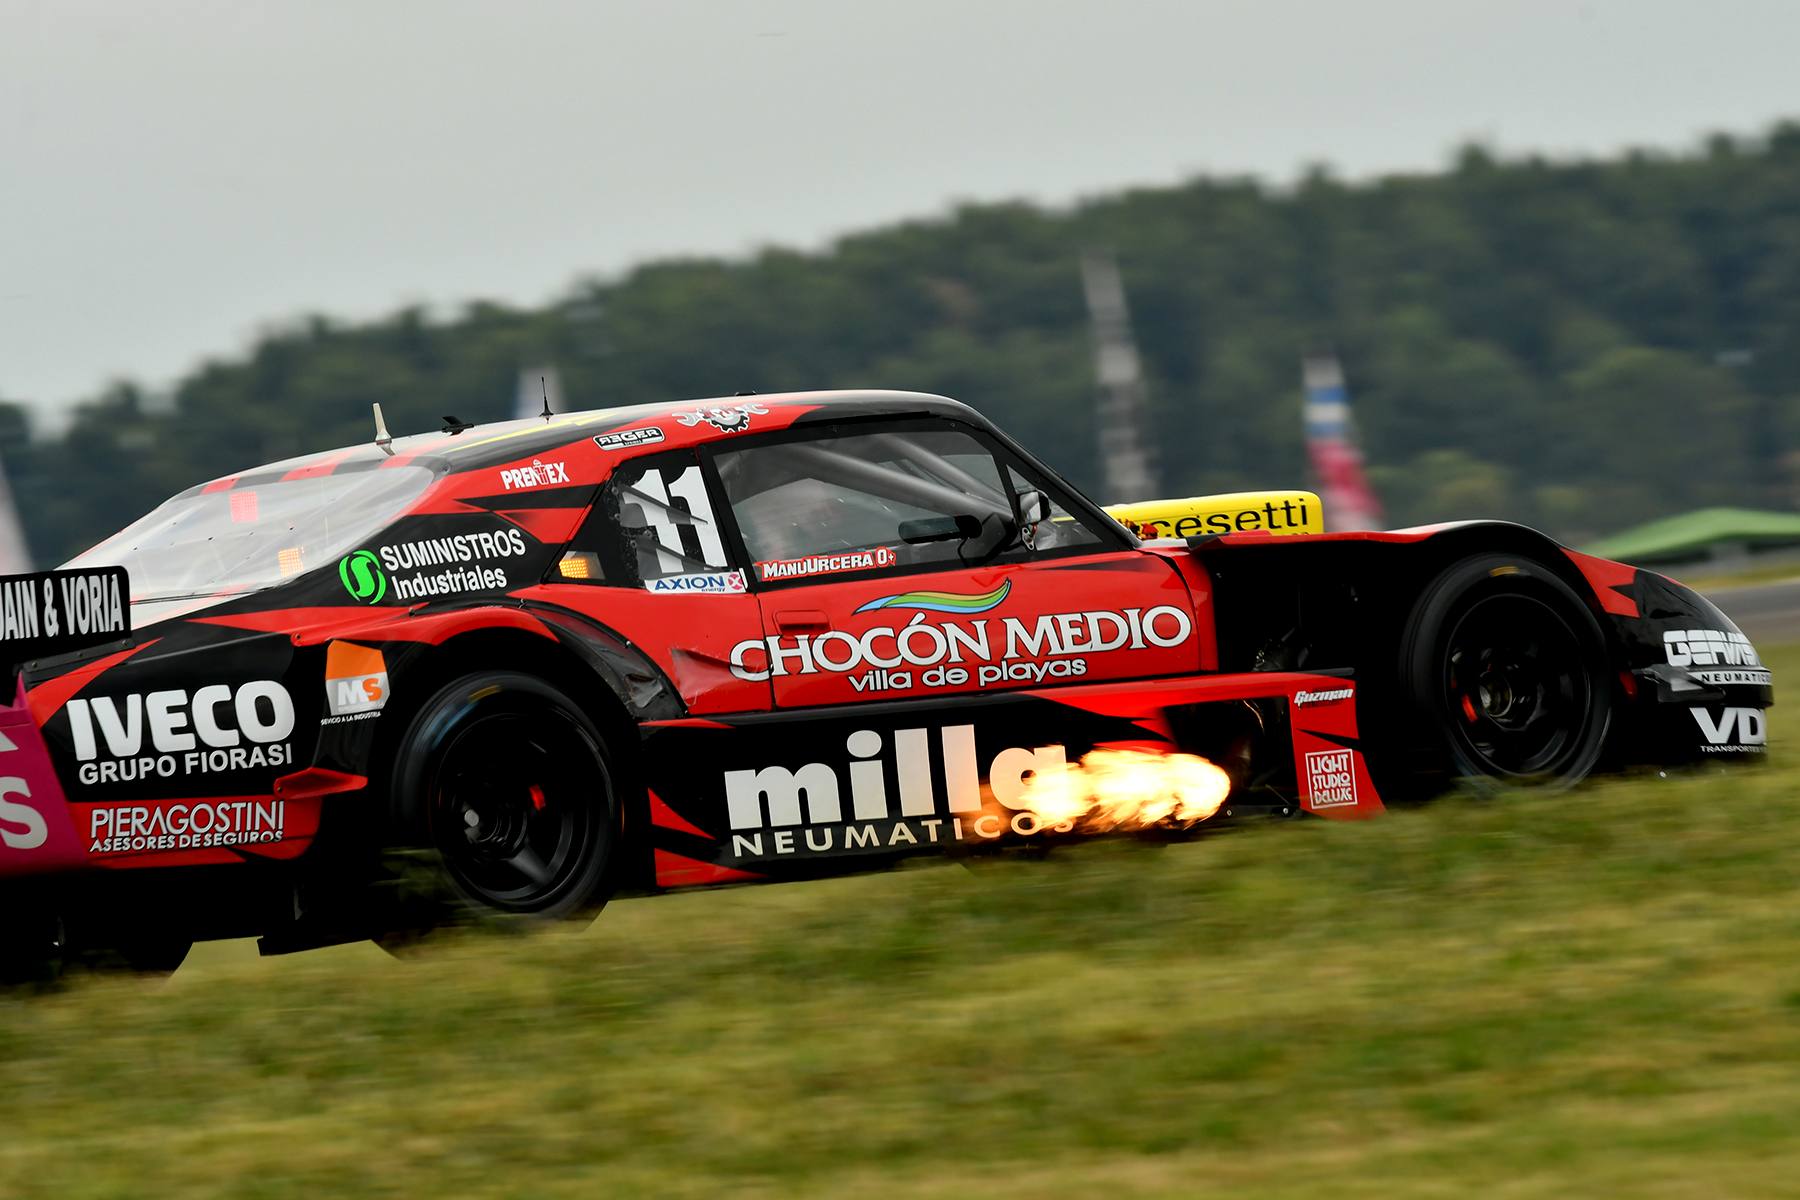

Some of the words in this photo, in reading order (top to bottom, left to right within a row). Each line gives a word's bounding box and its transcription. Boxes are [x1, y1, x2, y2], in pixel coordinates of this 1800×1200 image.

[500, 459, 570, 490] PRENTEX
[622, 466, 728, 574] 11
[380, 528, 526, 571] SUMINISTROS
[391, 565, 507, 600] Industriales
[655, 575, 726, 591] AXION
[43, 578, 59, 637] &
[61, 573, 124, 635] VORIA
[729, 612, 989, 682] CHOCÓN
[1001, 605, 1192, 656] MEDIO
[338, 678, 382, 706] MS
[848, 670, 912, 692] villa
[922, 665, 969, 687] de
[979, 657, 1087, 687] playas
[1293, 688, 1353, 707] Guzman
[65, 680, 296, 762] IVECO
[1689, 707, 1767, 744] VD
[79, 756, 177, 785] GRUPO
[184, 743, 293, 775] FIORASI
[1310, 754, 1349, 774] LIGHT
[1312, 772, 1351, 791] STUDIO
[1314, 787, 1353, 804] DELUXE
[91, 801, 285, 838] PIERAGOSTINI
[90, 836, 175, 852] ASESORES
[179, 833, 201, 848] DE
[203, 829, 284, 846] SEGUROS
